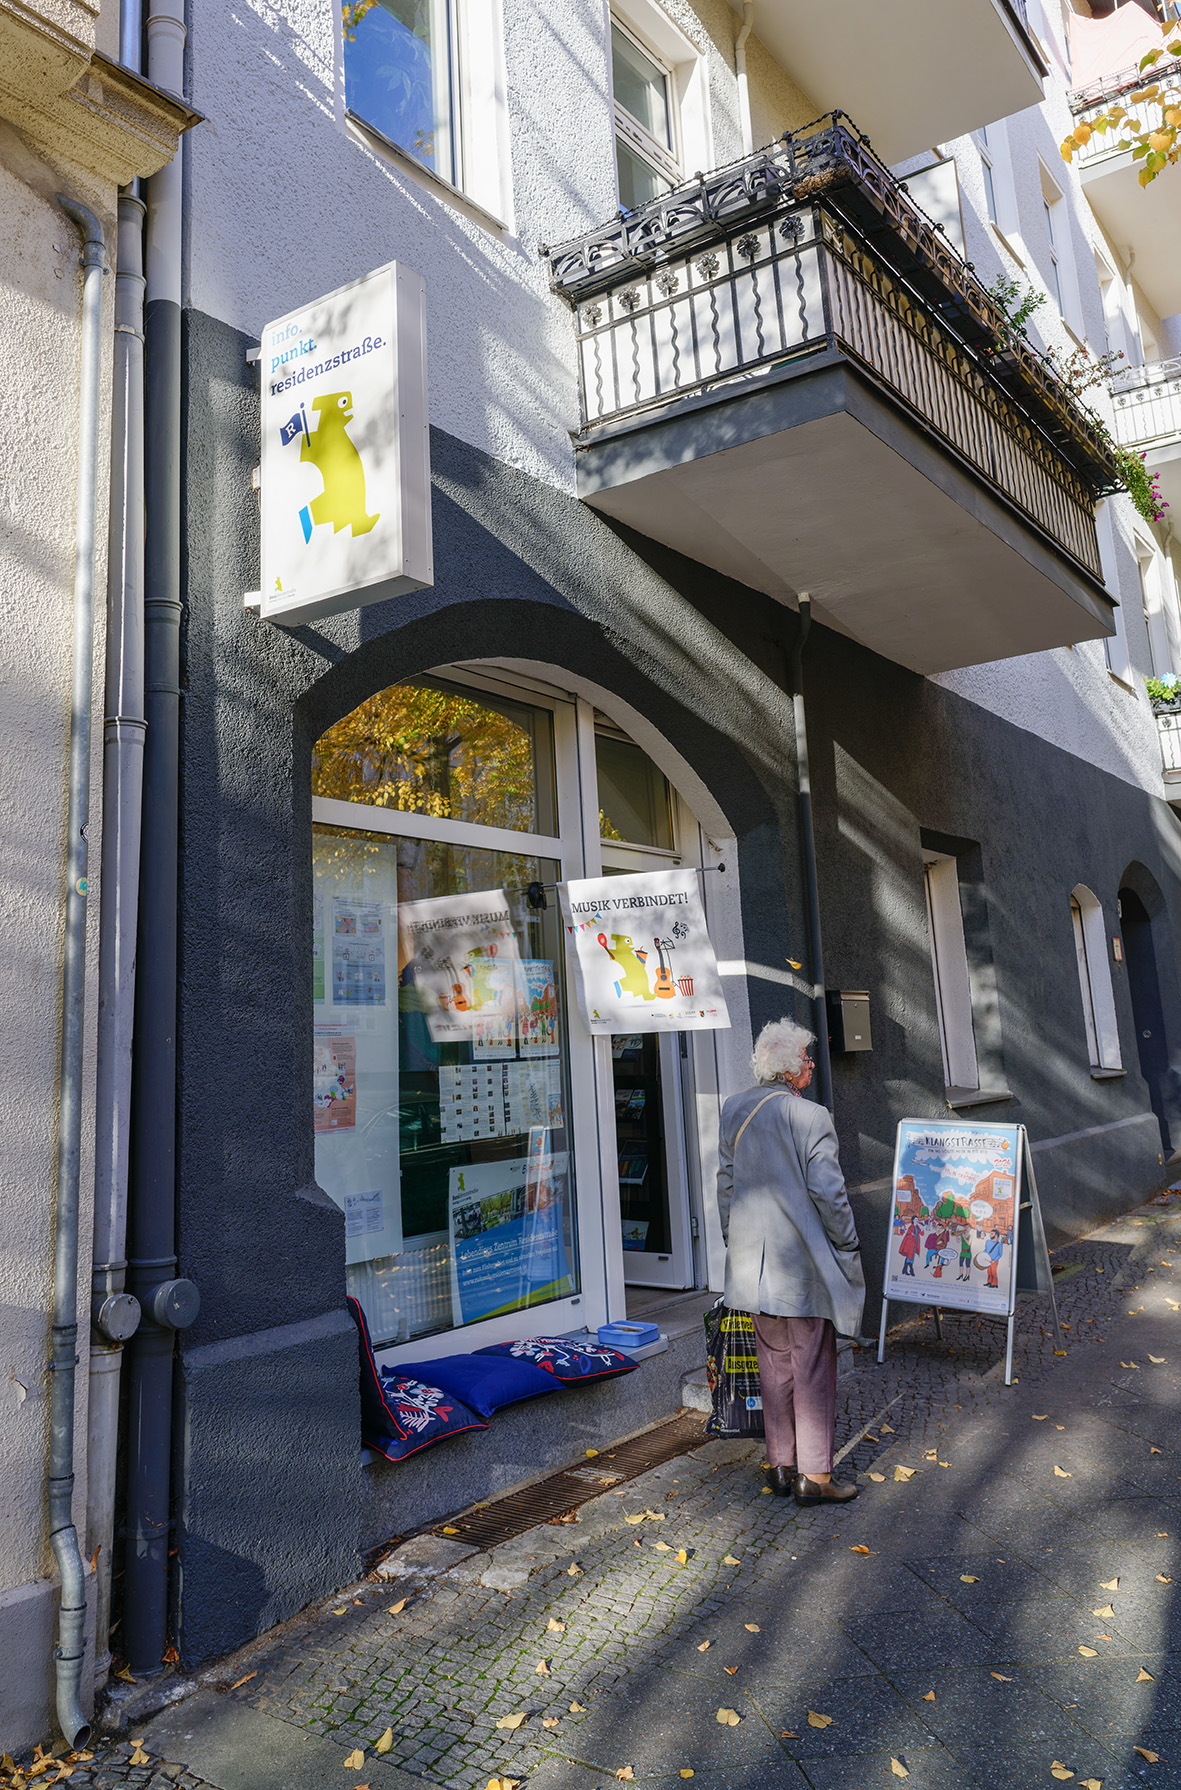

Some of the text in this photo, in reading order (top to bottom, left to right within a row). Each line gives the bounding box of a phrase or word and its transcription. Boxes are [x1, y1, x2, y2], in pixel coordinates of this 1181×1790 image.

[272, 322, 303, 346] info.
[271, 338, 318, 374] punkt.
[271, 336, 387, 396] residenzstraße.
[285, 422, 297, 438] R
[571, 892, 689, 914] MUSIK VERBINDET!
[925, 1136, 987, 1148] KLANGSTRASSE
[494, 1240, 518, 1252] Zentrum
